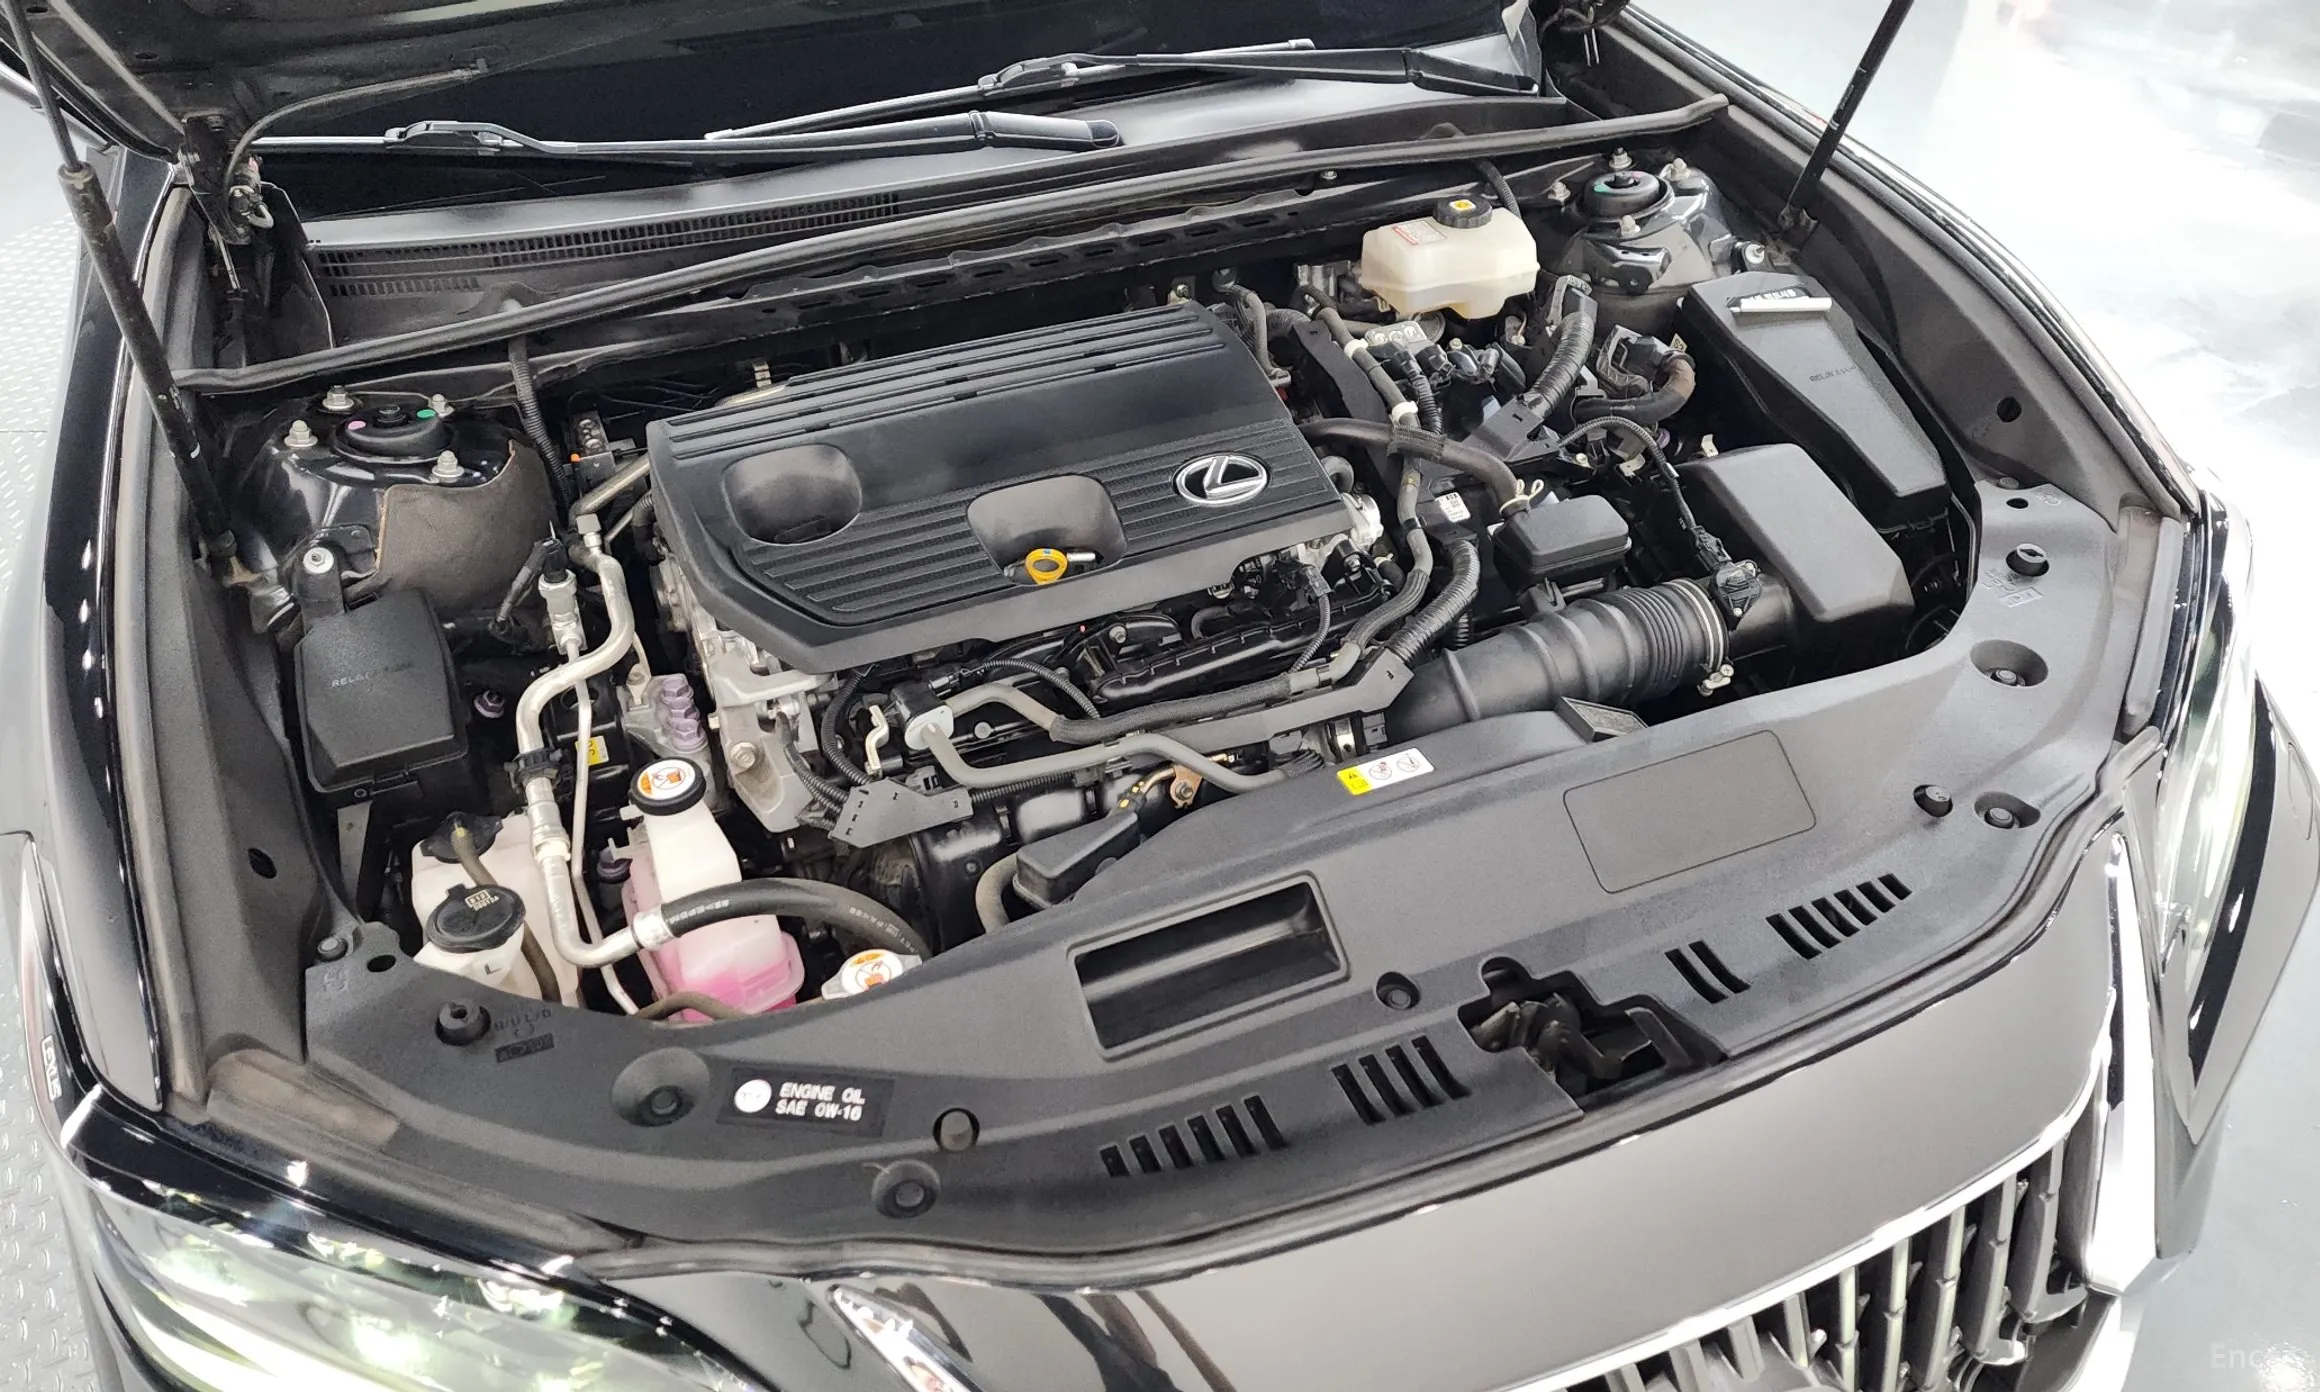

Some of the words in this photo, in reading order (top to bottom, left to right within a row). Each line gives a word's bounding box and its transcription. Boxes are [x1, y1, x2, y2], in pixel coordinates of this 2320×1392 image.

[779, 1081, 836, 1101] ENGINE
[841, 1087, 866, 1105] OIL
[775, 1099, 809, 1117] SAE
[814, 1102, 863, 1122] 0W-16
